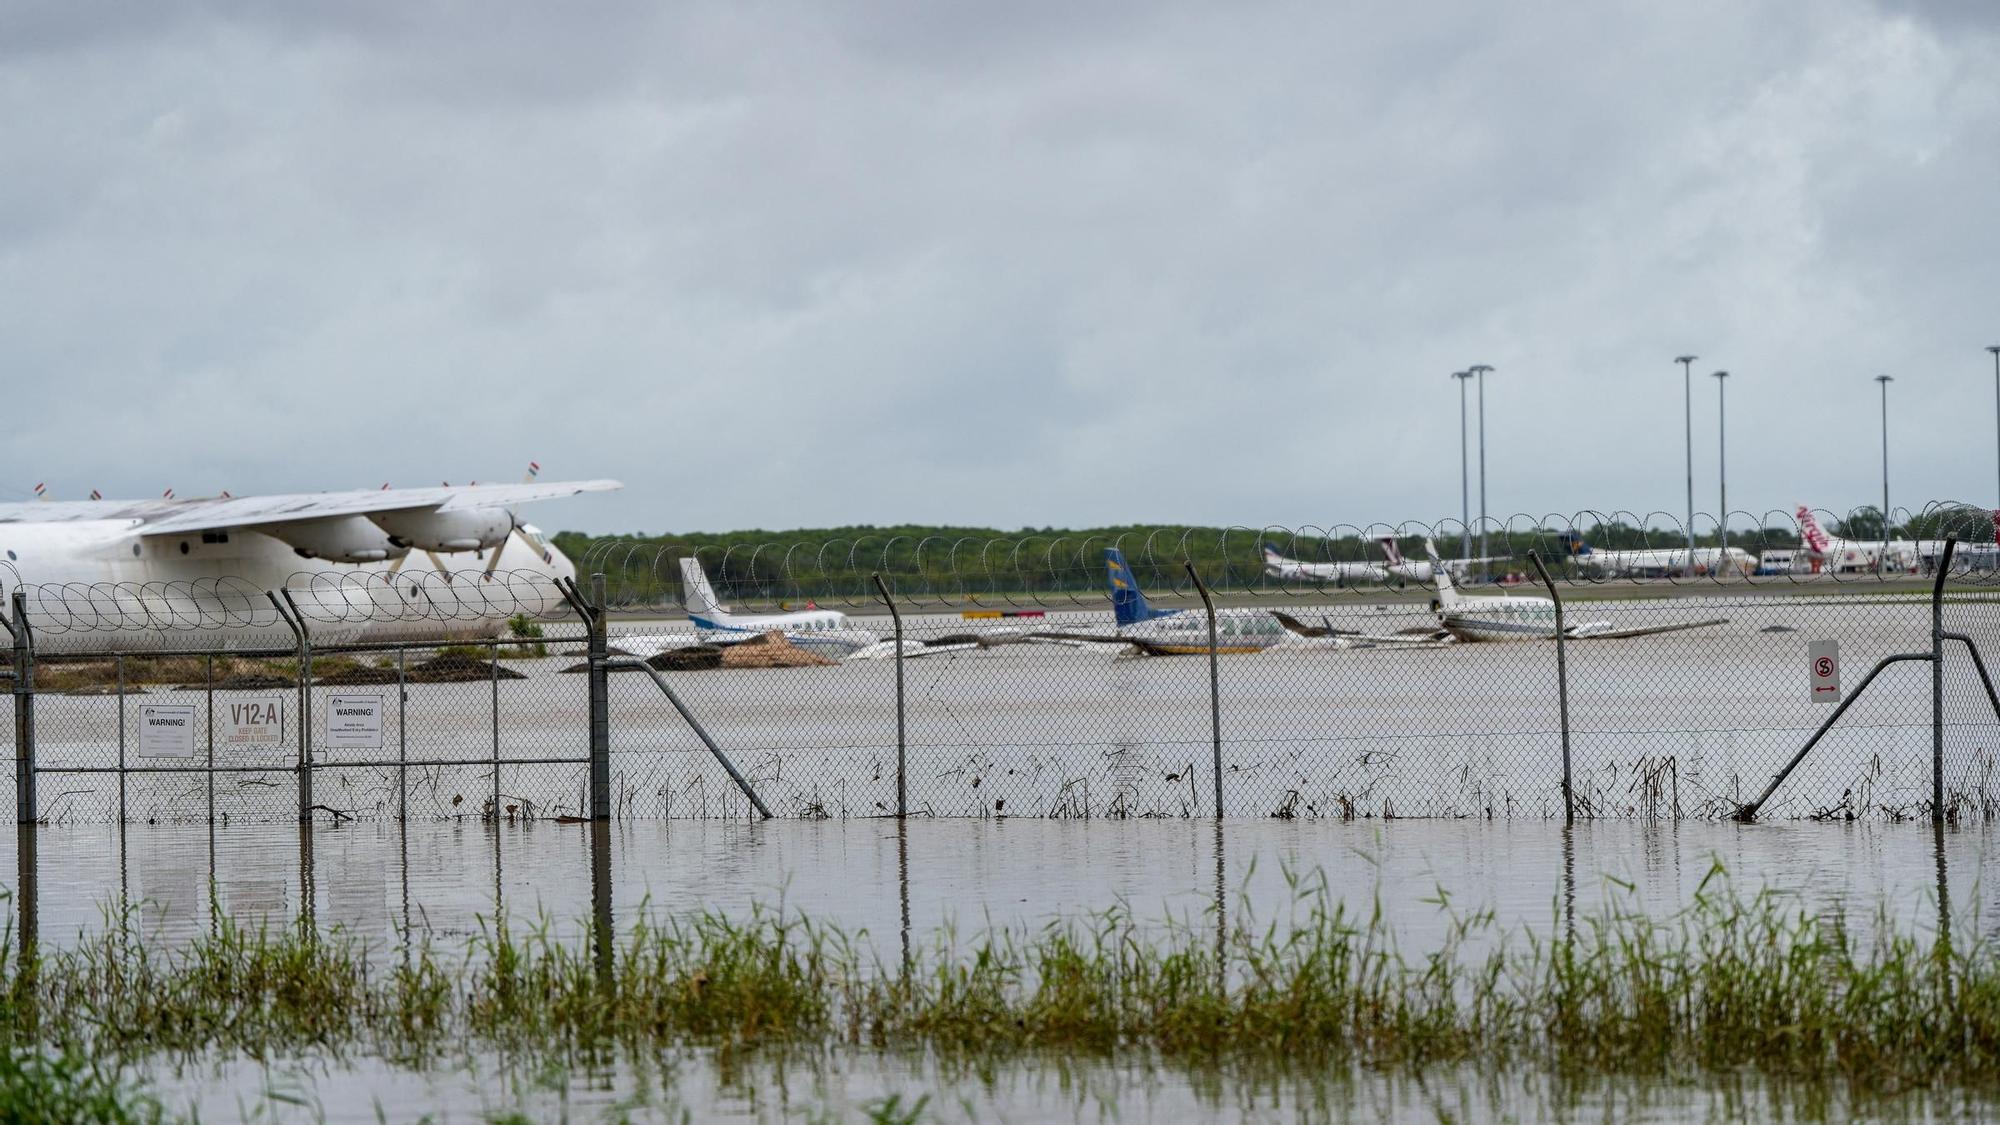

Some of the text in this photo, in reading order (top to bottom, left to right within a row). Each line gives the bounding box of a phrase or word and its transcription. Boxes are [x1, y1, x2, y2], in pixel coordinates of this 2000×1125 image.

[1819, 660, 1830, 675] S
[231, 703, 278, 725] V12-A
[335, 708, 374, 716] WARNING!
[149, 718, 186, 727] WARNING!
[238, 727, 267, 735] KEEP GATE
[228, 735, 250, 743] CLOSED
[256, 735, 279, 743] LOCKED
